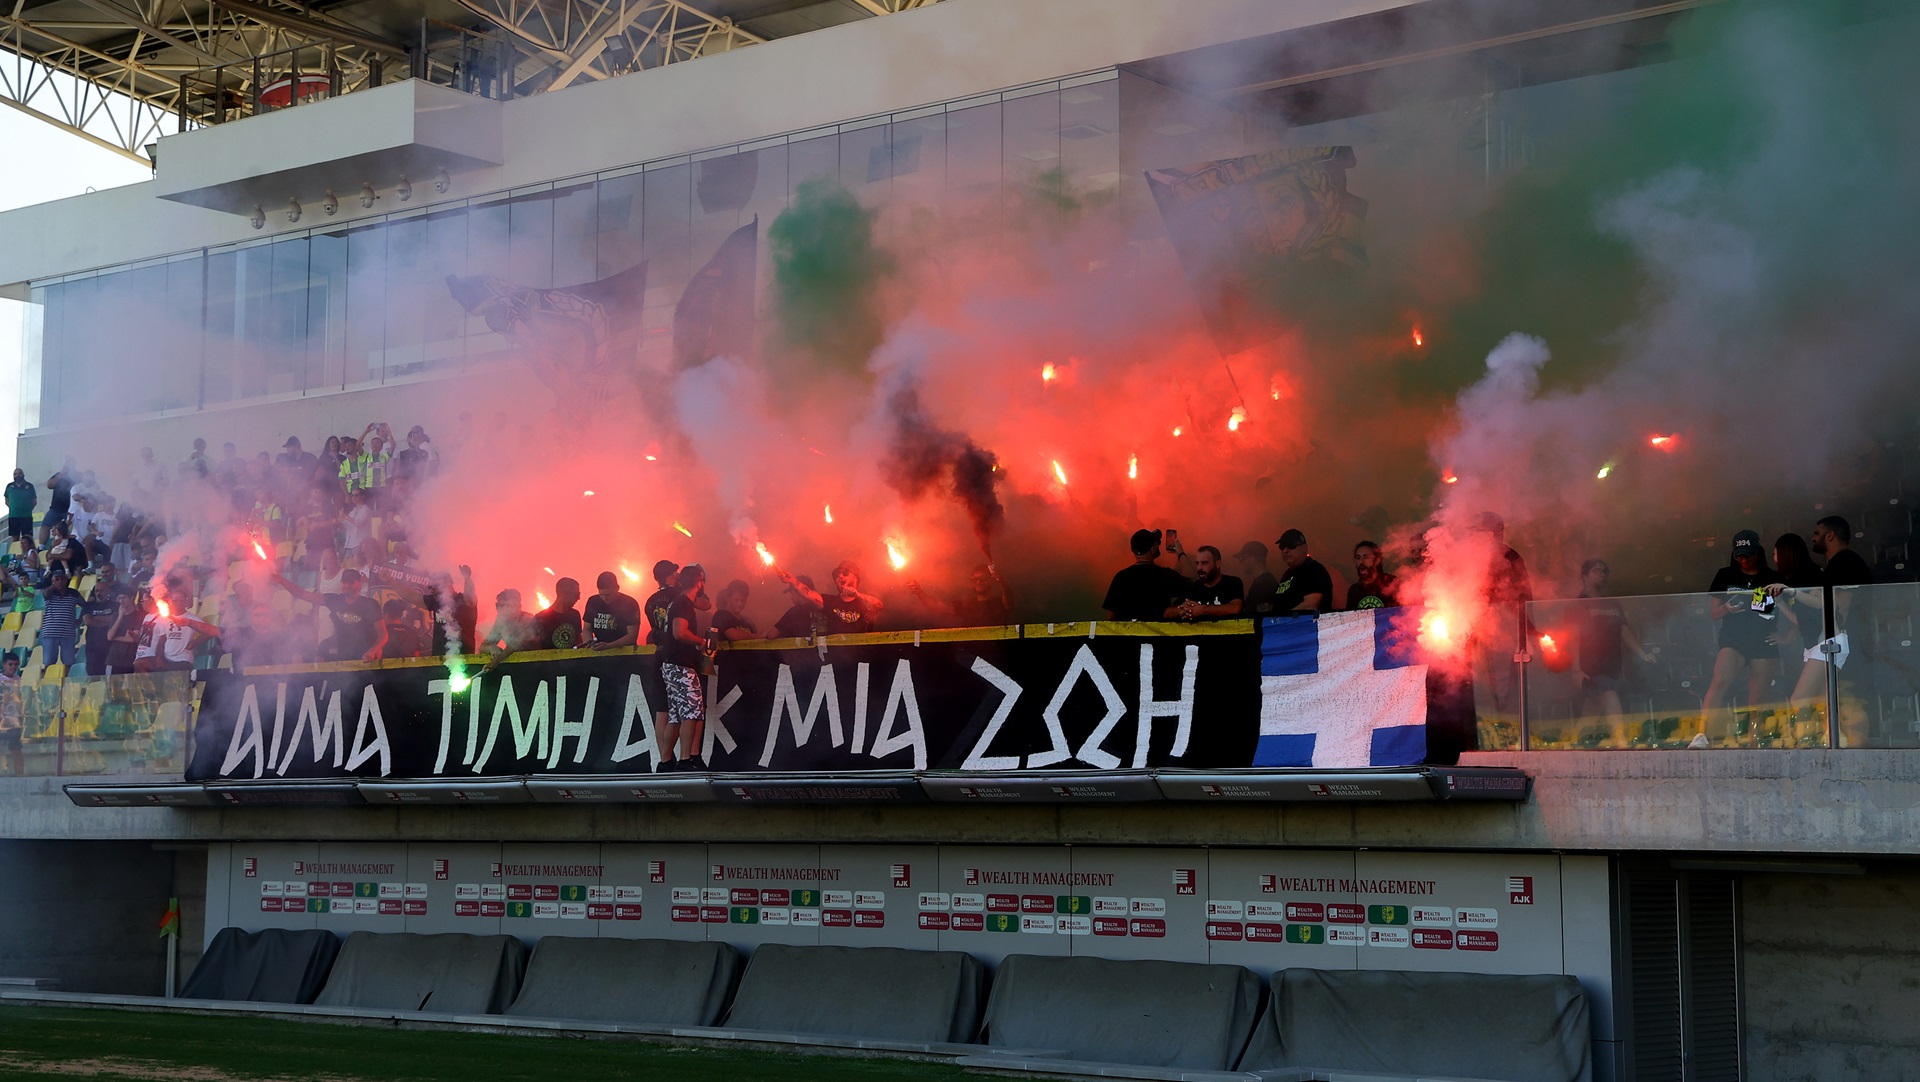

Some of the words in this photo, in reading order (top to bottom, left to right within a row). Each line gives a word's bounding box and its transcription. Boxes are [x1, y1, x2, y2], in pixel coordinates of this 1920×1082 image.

[373, 565, 404, 580] SND
[427, 674, 600, 775] ΤΙΜΗ
[610, 664, 743, 774] ΑΚ
[757, 658, 928, 770] ΜΙΑ
[961, 642, 1200, 770] ΖΩΗ
[306, 864, 337, 874] WEALTH
[340, 864, 394, 874] MANAGEMENT
[505, 865, 541, 876] WEALTH
[543, 866, 604, 877] MANAGEMENT
[727, 867, 768, 880] WEALTH
[770, 868, 841, 881] MANAGEMENT
[982, 871, 1029, 885] WEALTH
[1032, 873, 1114, 887] MANAGEMENT
[1280, 878, 1335, 892] WEALTH
[1339, 879, 1435, 895] MANAGEMENT
